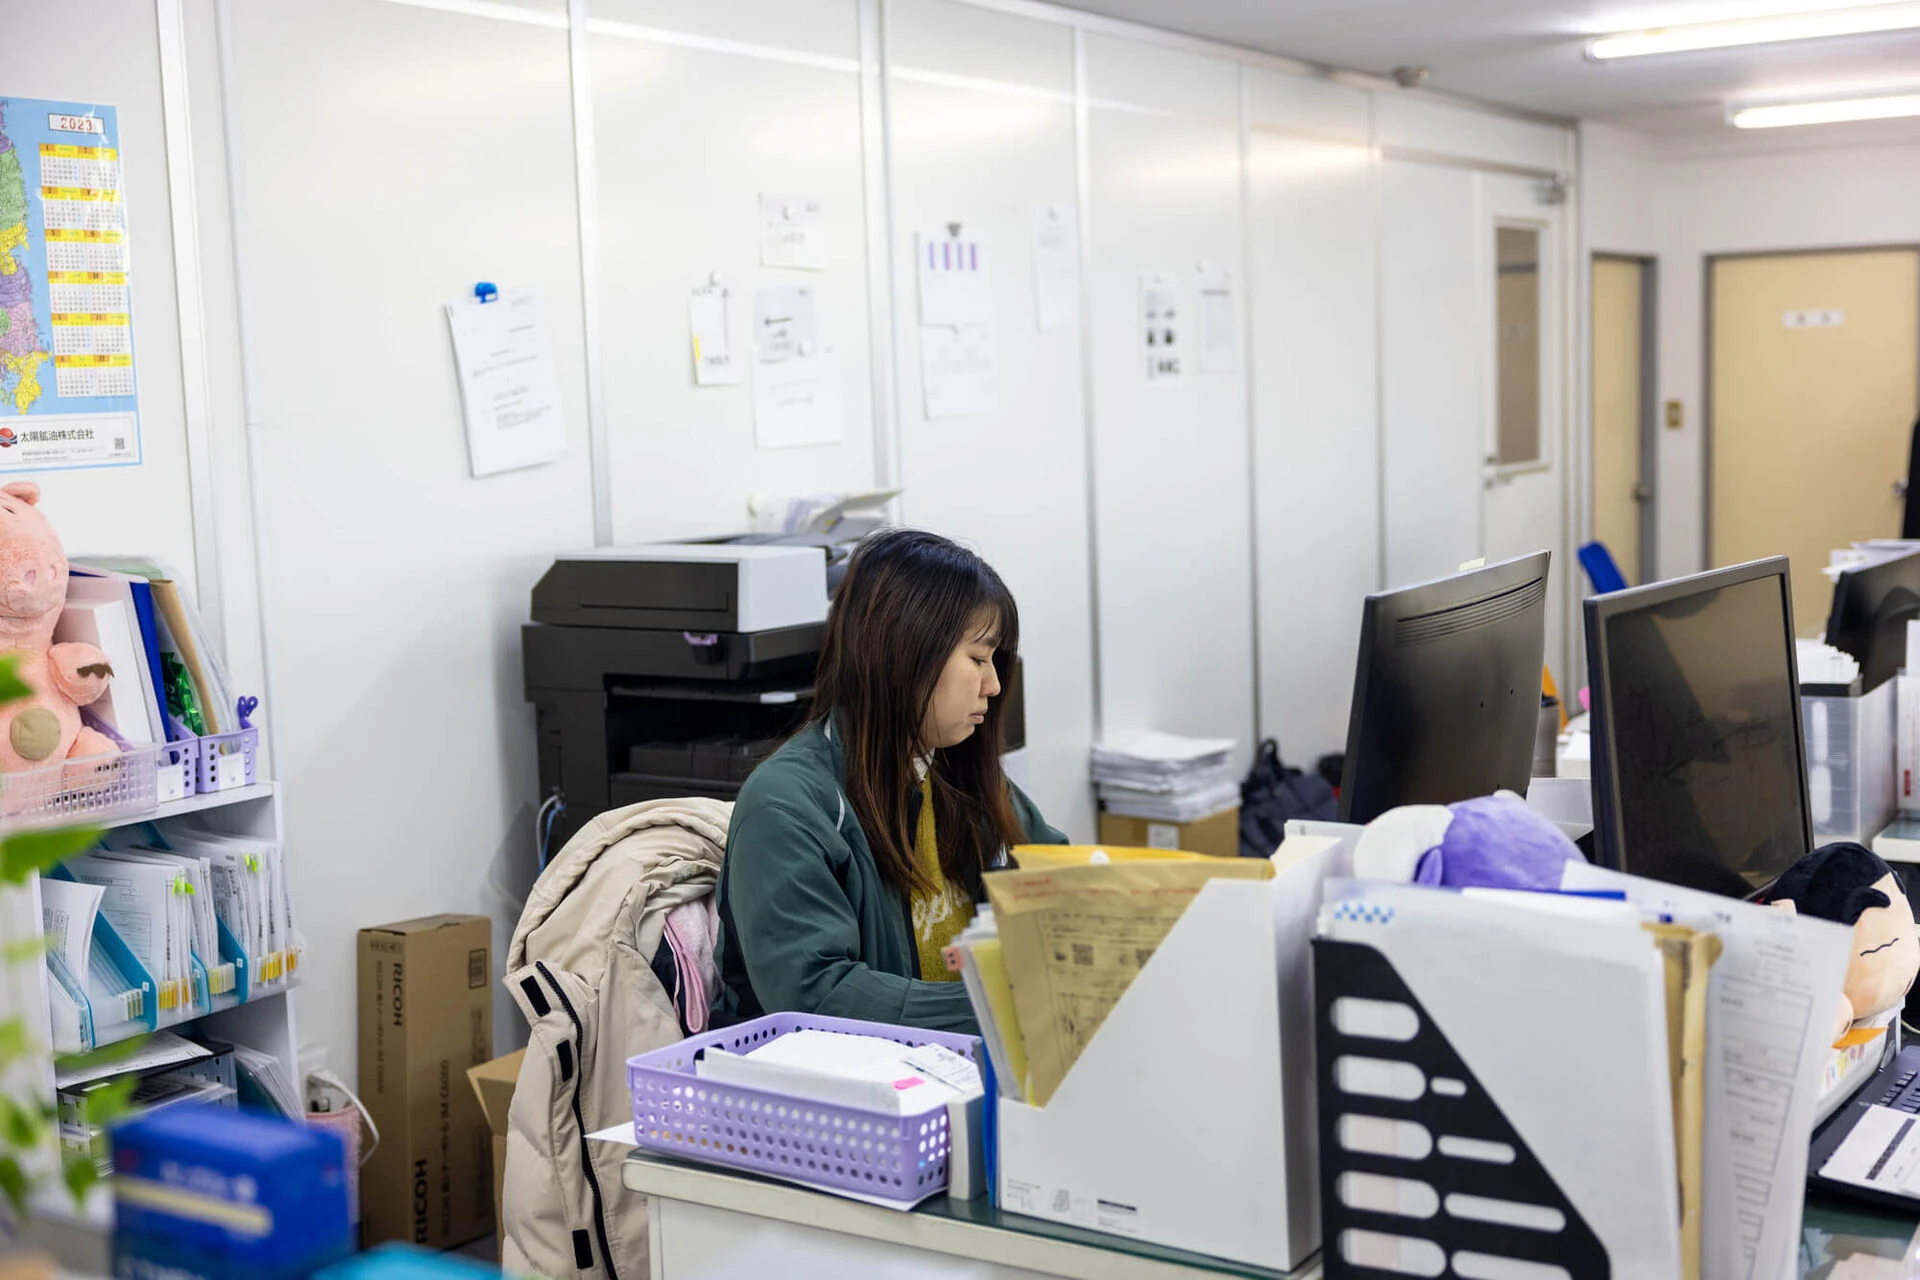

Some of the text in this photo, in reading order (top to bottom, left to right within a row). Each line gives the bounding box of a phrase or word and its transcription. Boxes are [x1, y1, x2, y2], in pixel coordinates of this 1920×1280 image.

[61, 117, 93, 131] 2023
[20, 429, 94, 442] 太陽鉱油株式会社
[393, 963, 403, 1027] RICOH
[415, 1159, 428, 1244] RICOH
